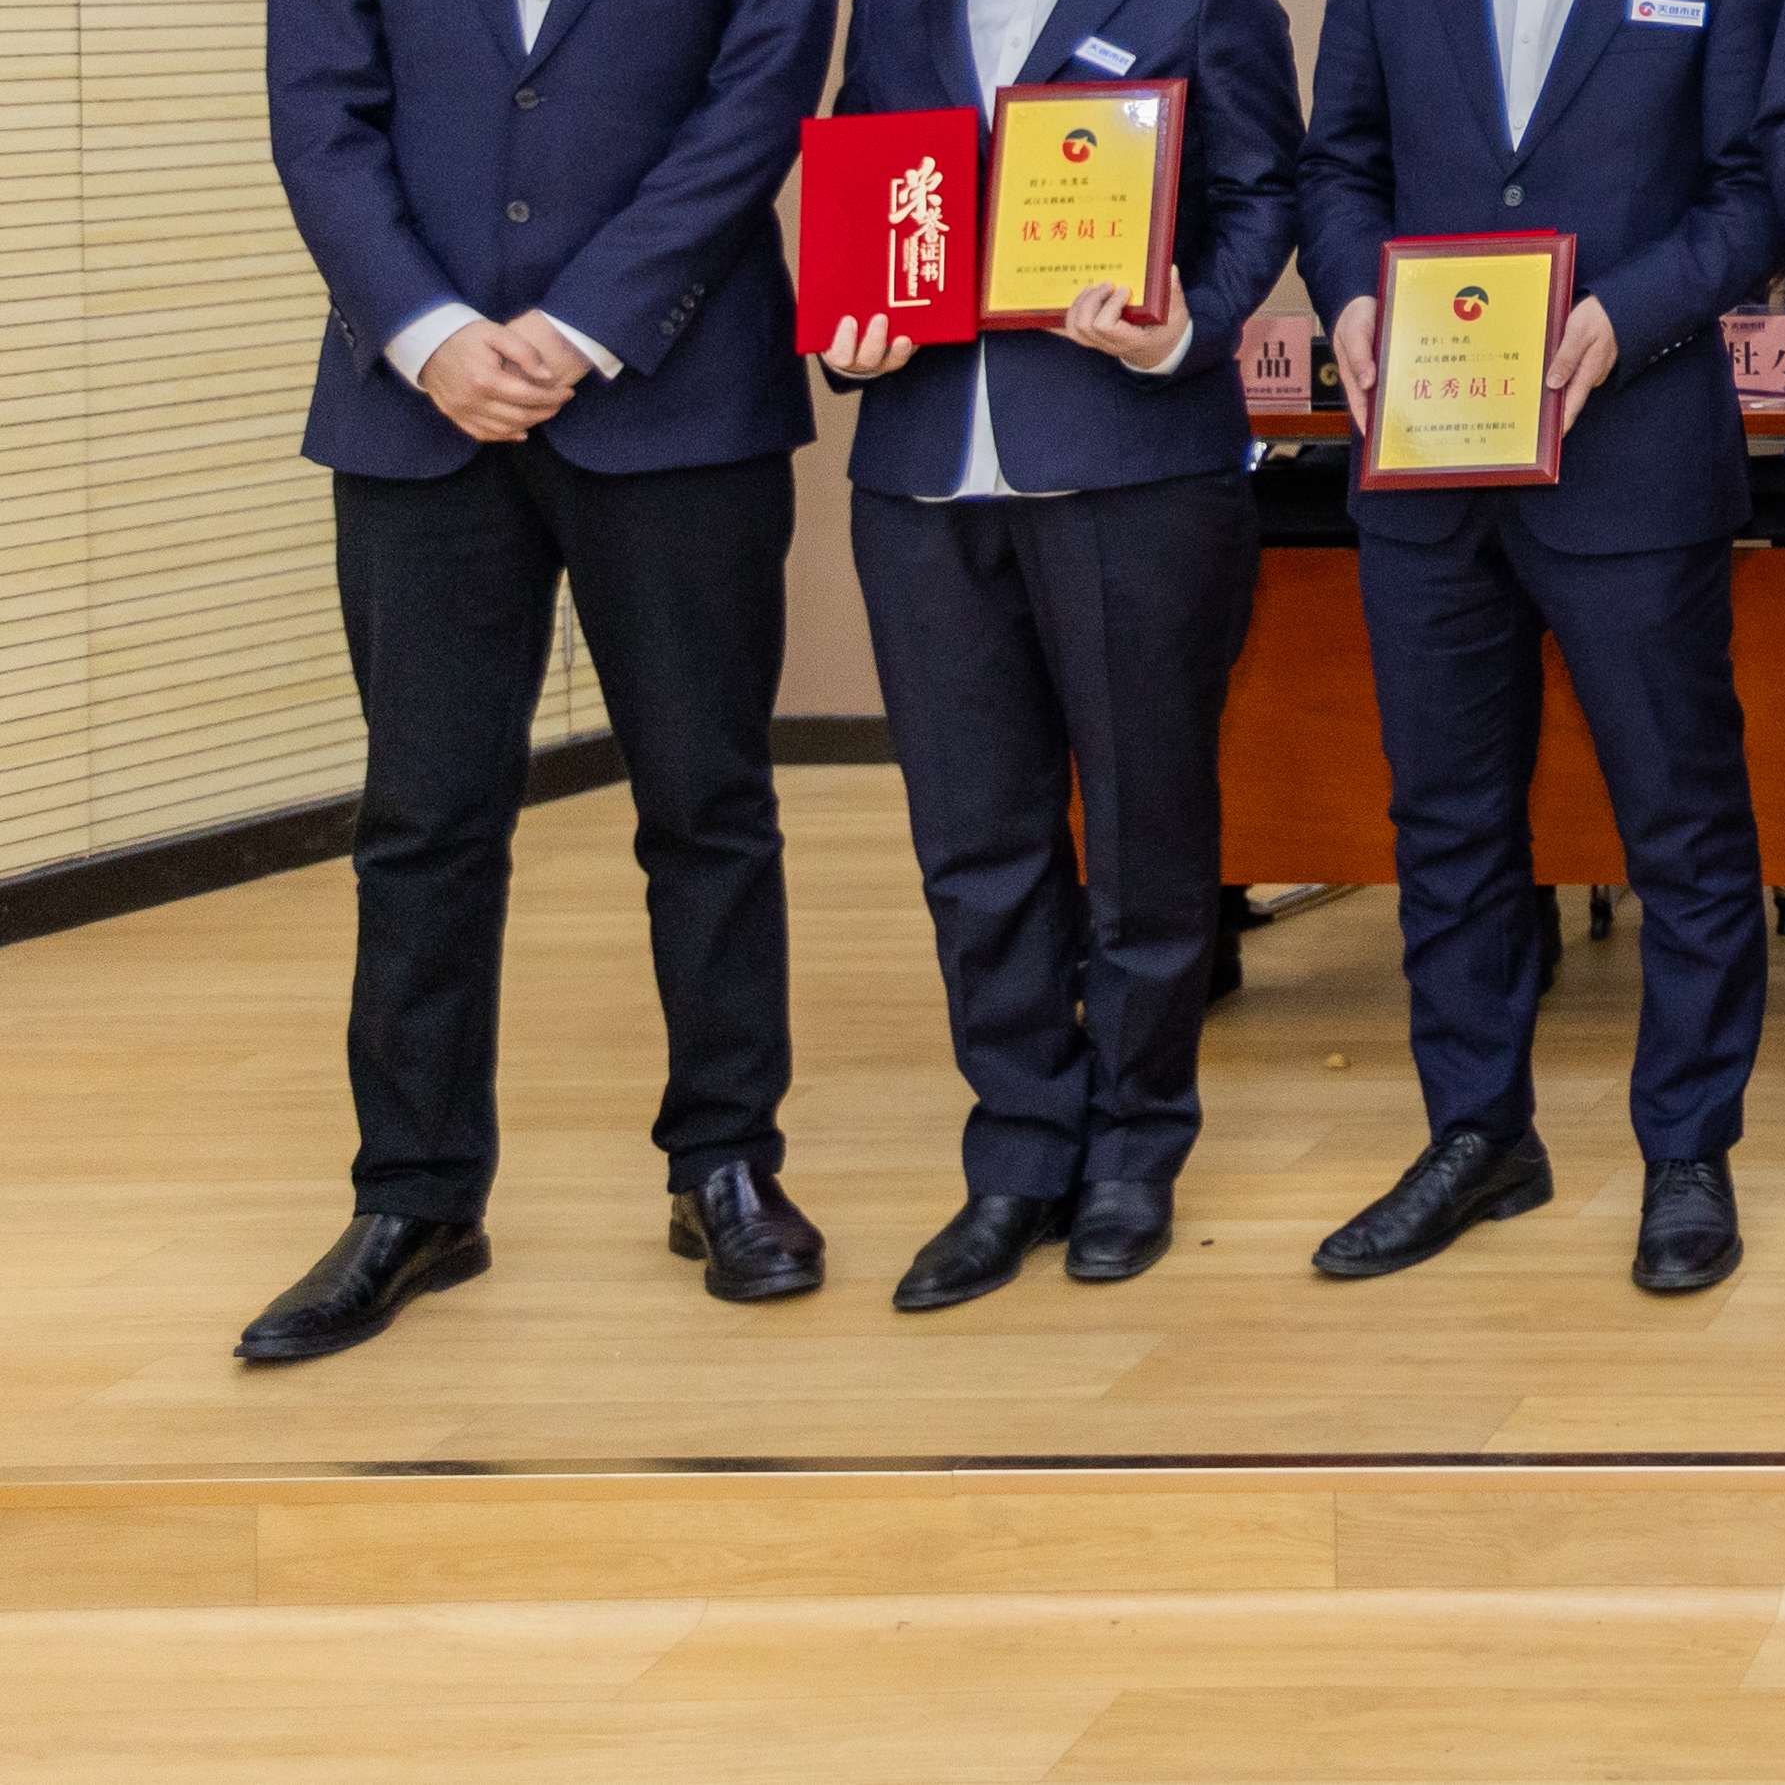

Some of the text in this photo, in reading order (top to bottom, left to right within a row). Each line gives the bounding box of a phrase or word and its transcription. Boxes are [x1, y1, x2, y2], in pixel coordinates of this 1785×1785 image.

[1022, 218, 1124, 242] 优秀员工
[1413, 377, 1515, 401] 优秀员工
